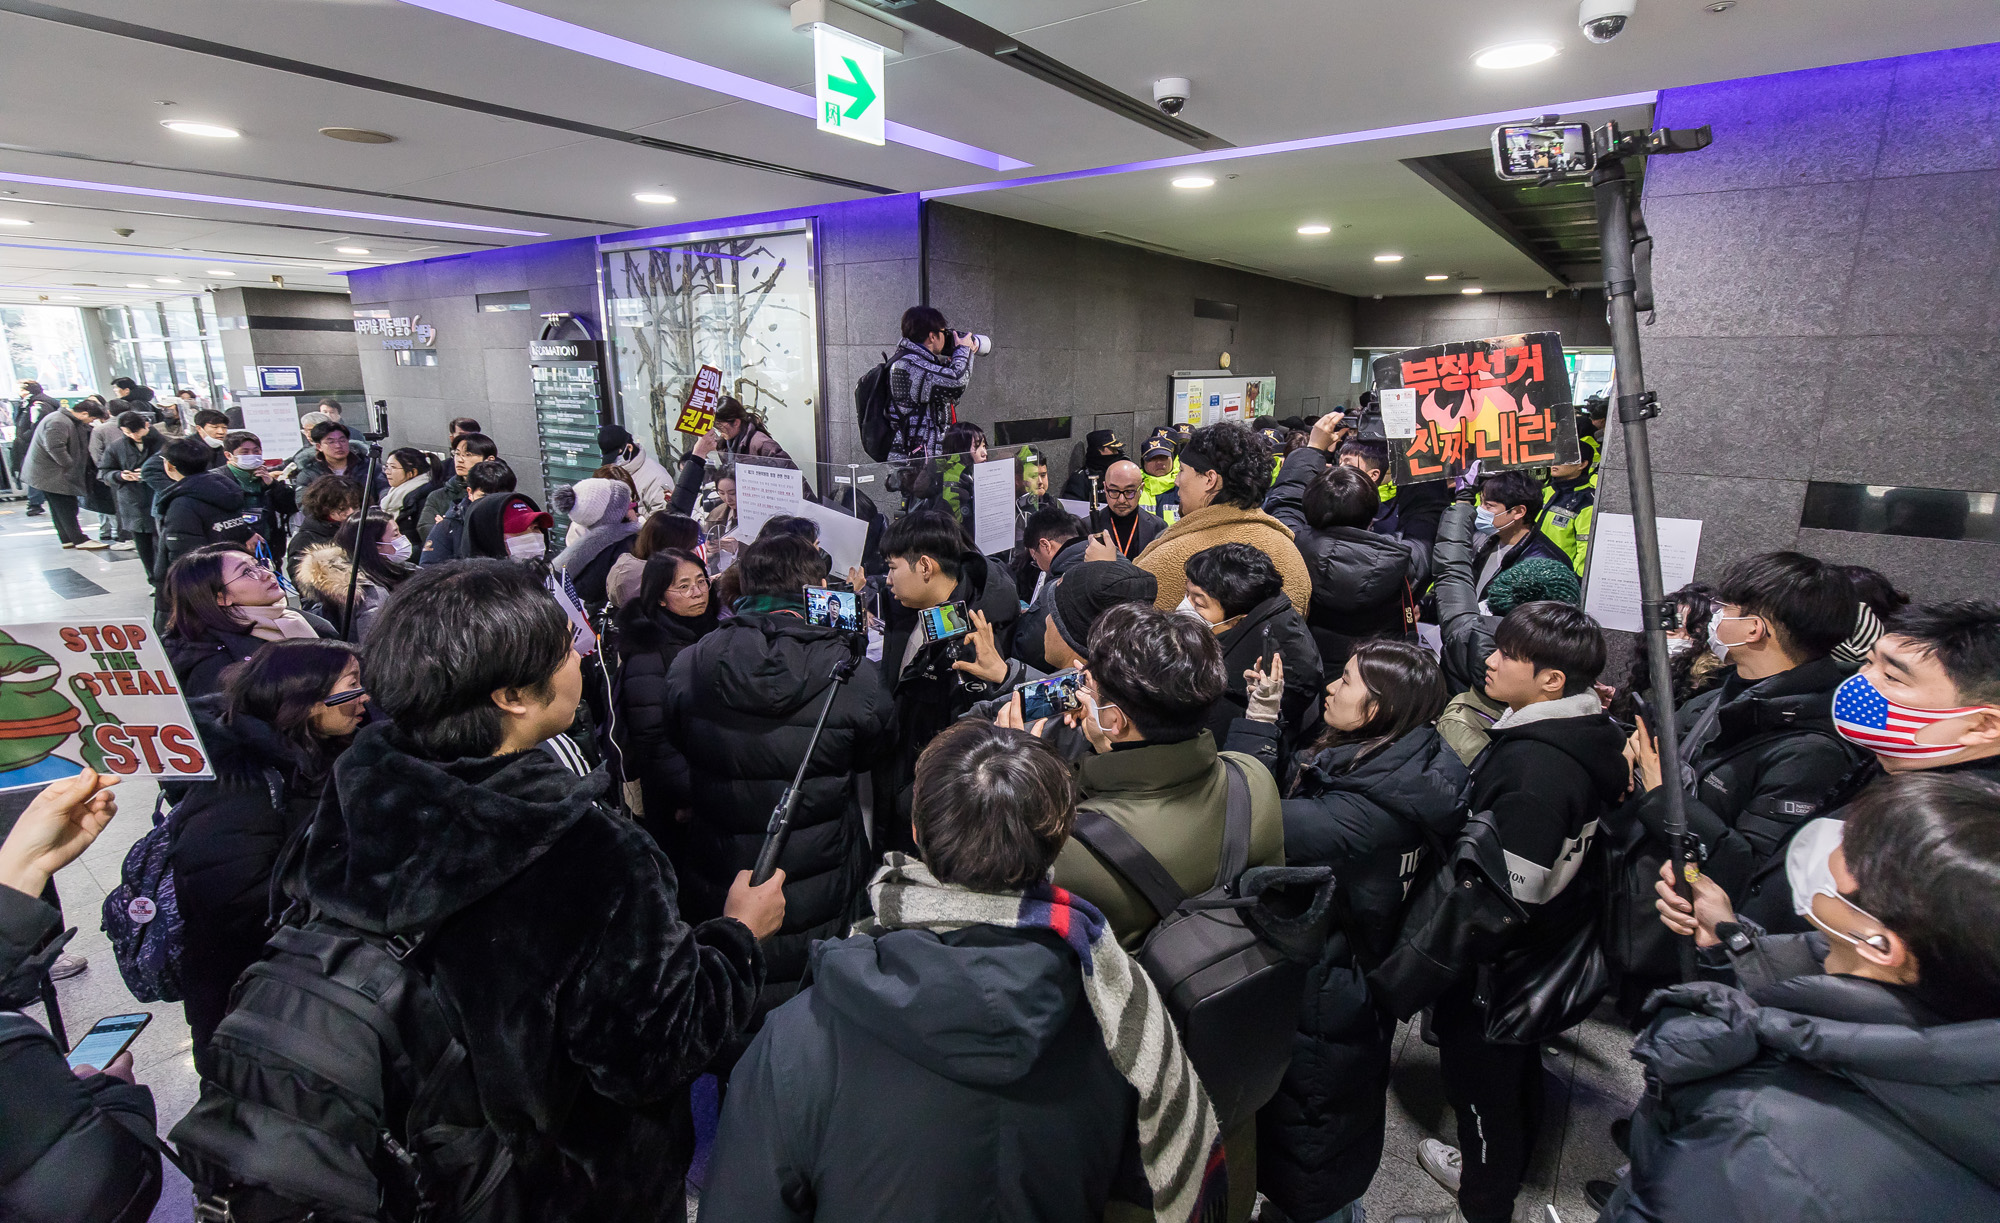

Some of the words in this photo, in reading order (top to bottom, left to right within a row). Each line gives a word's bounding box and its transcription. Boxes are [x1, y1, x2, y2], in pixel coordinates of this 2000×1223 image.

[1401, 343, 1545, 396] 부정선거
[1405, 416, 1471, 476] 진짜
[1474, 408, 1557, 465] 내란
[222, 516, 244, 530] DESCE
[59, 624, 147, 652] STOP
[90, 651, 142, 671] THE
[74, 670, 179, 697] STEAL
[95, 724, 206, 775] STS
[1508, 870, 1526, 885] ION
